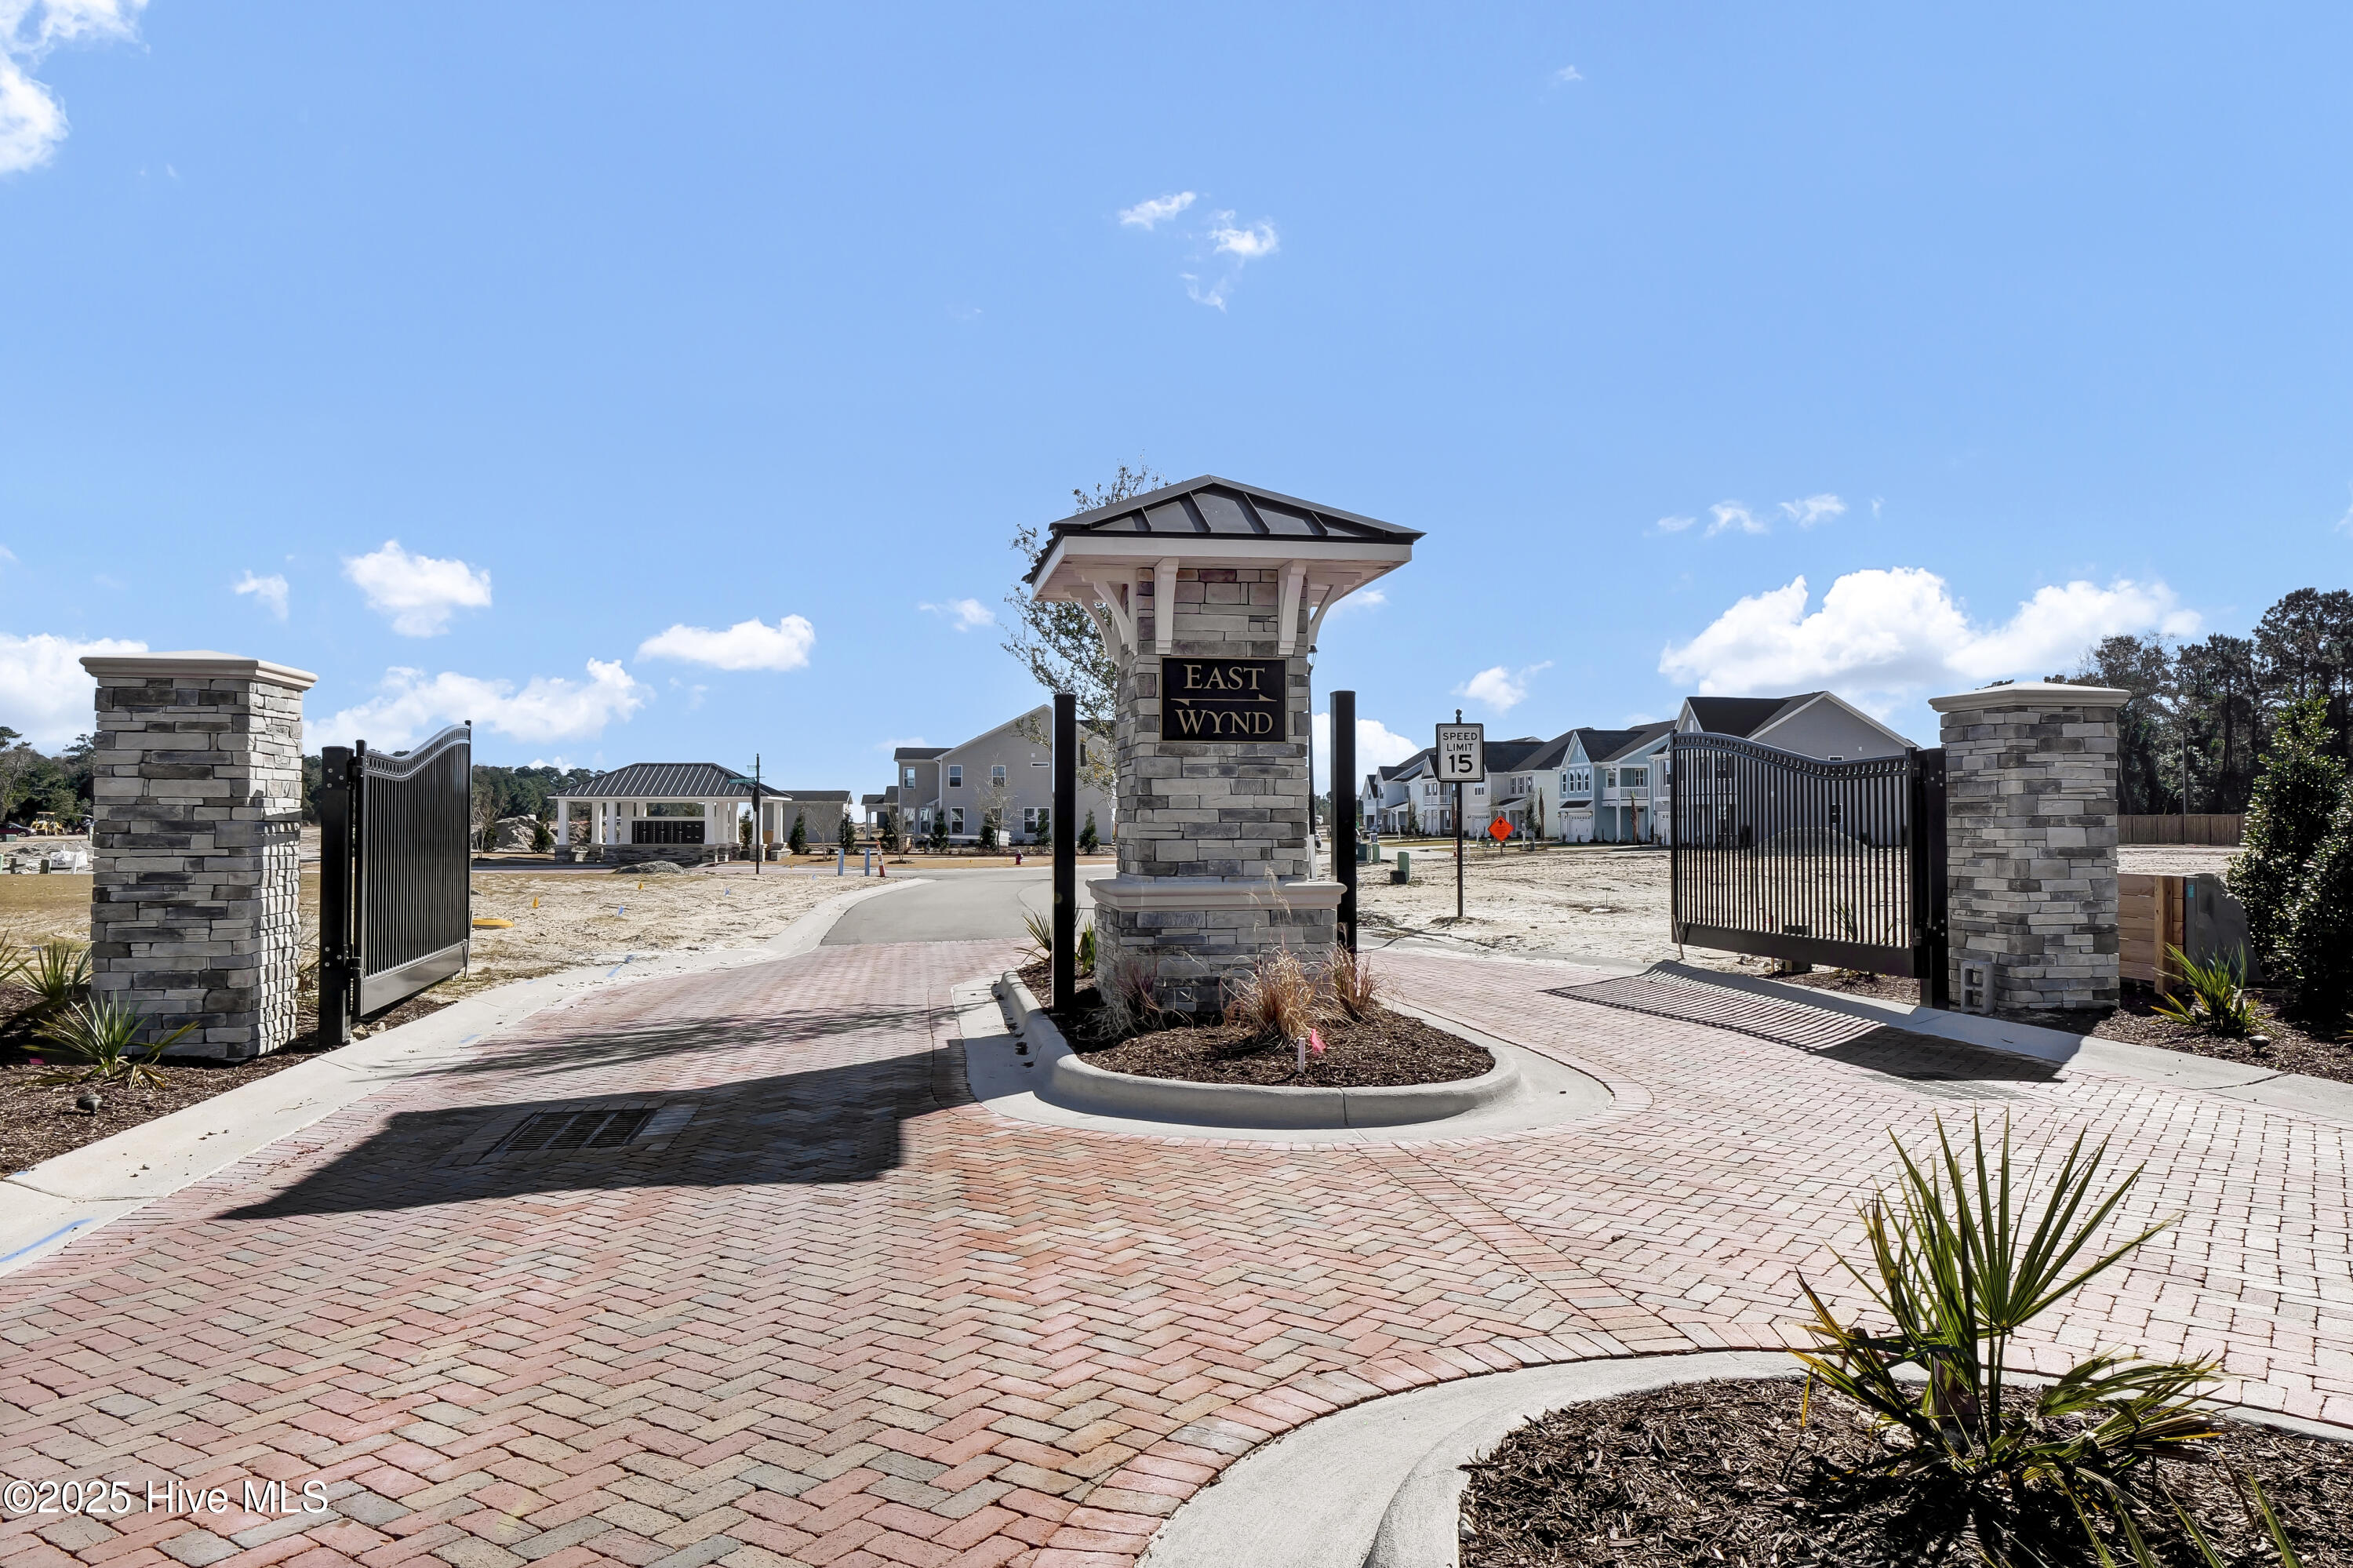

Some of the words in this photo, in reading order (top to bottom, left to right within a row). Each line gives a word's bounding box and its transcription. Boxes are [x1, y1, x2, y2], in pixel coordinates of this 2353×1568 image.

[1183, 664, 1265, 690] EAST
[1175, 709, 1274, 735] WYND
[1442, 732, 1478, 740] SPEED
[1446, 743, 1474, 751] LIMIT
[1449, 755, 1473, 773] 15
